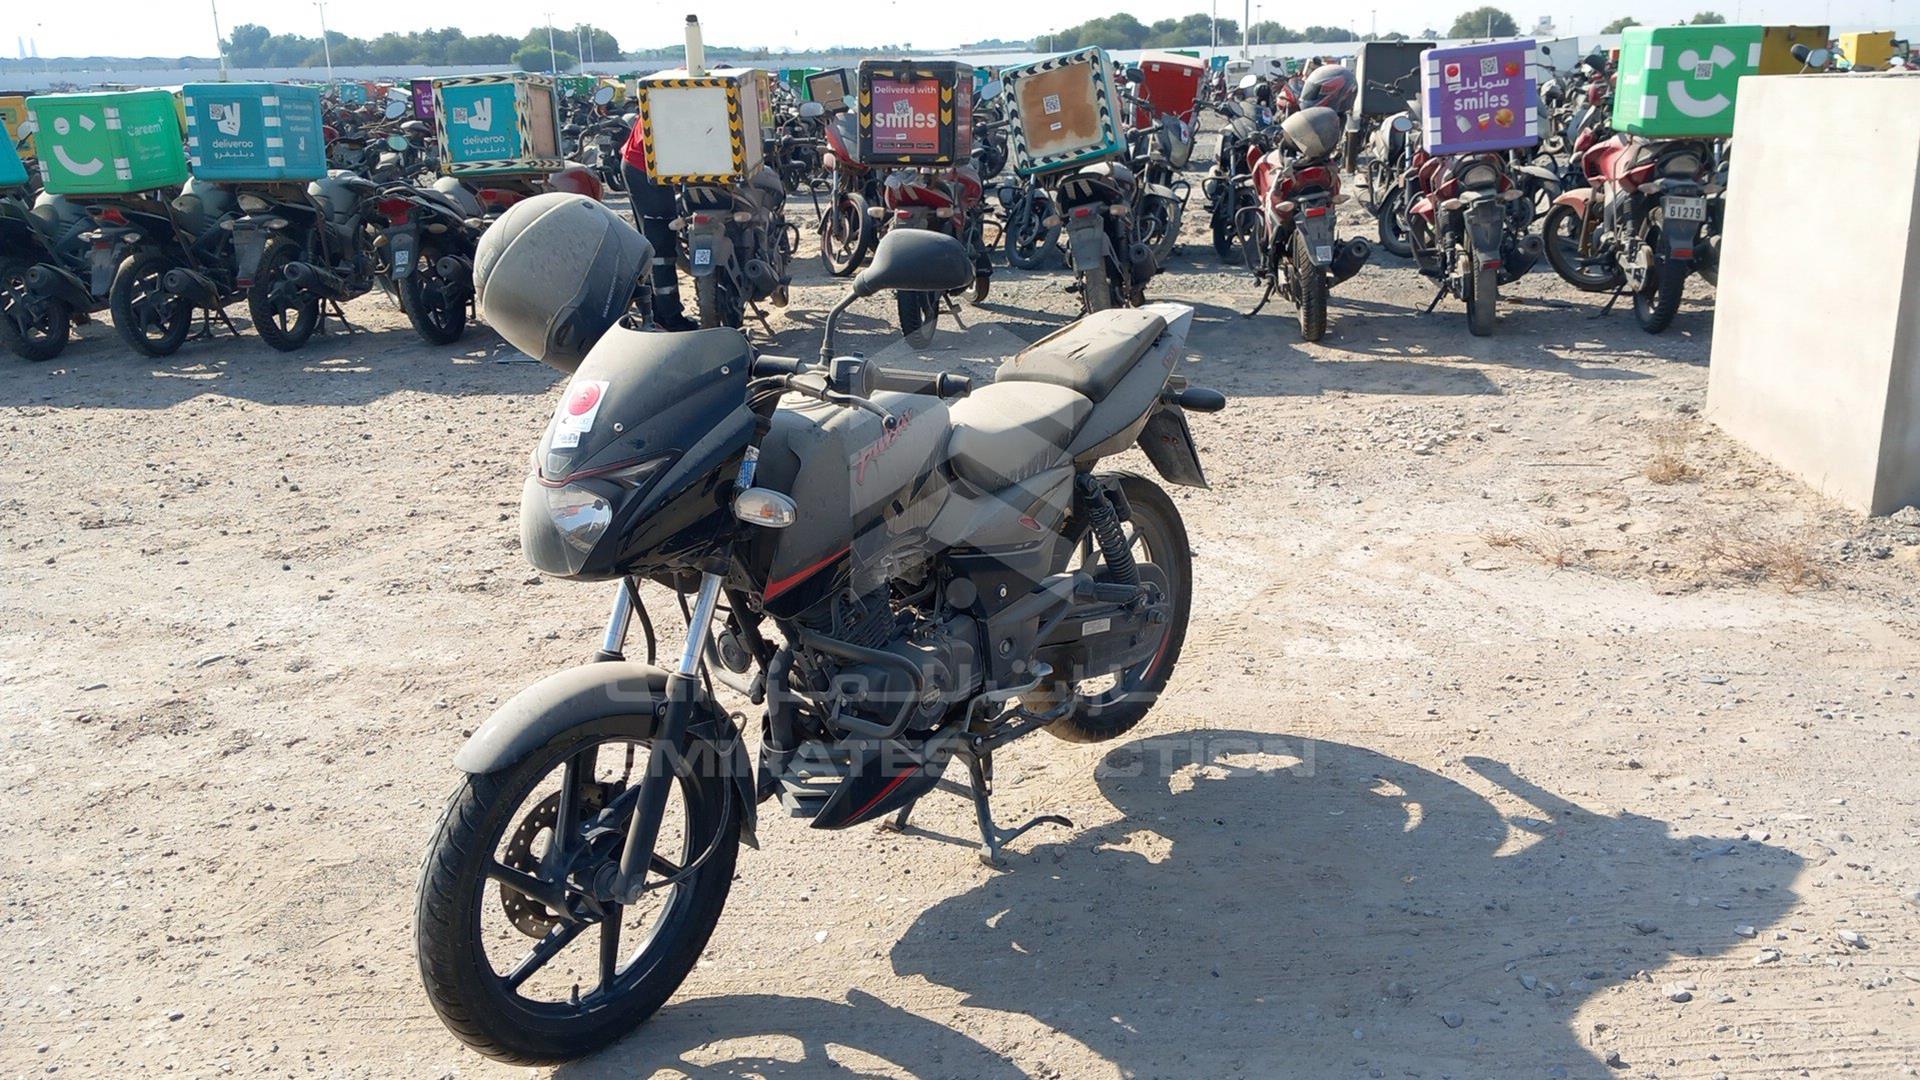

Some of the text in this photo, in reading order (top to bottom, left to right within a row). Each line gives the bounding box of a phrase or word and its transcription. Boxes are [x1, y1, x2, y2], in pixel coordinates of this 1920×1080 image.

[874, 85, 937, 94] Delivered with
[1454, 91, 1510, 111] smiles
[212, 138, 254, 149] deliveroo
[462, 134, 505, 146] deliveroo
[1670, 206, 1702, 219] 61279
